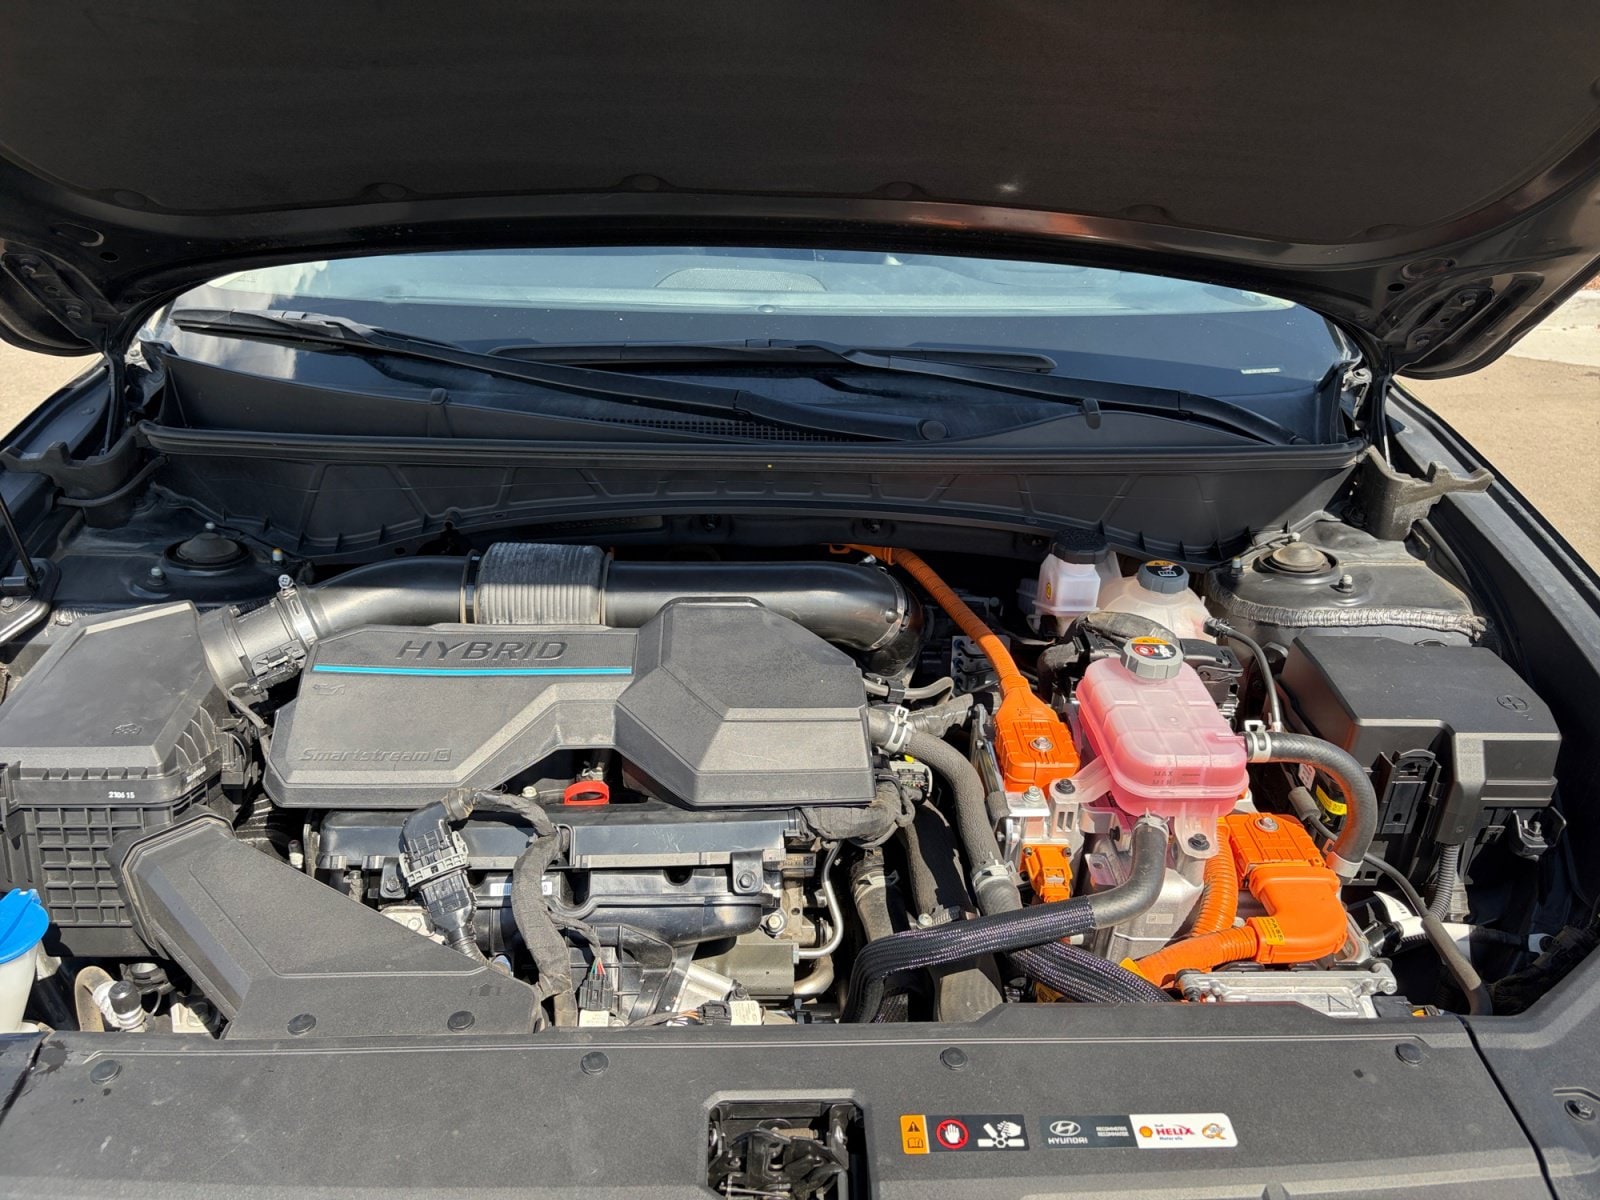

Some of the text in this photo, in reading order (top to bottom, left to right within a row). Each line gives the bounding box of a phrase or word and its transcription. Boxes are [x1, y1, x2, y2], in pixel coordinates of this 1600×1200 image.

[396, 639, 569, 661] HYBRID
[299, 747, 430, 762] Smartstream
[1156, 1127, 1194, 1136] HELIX
[1047, 1136, 1089, 1145] HYUNDAI
